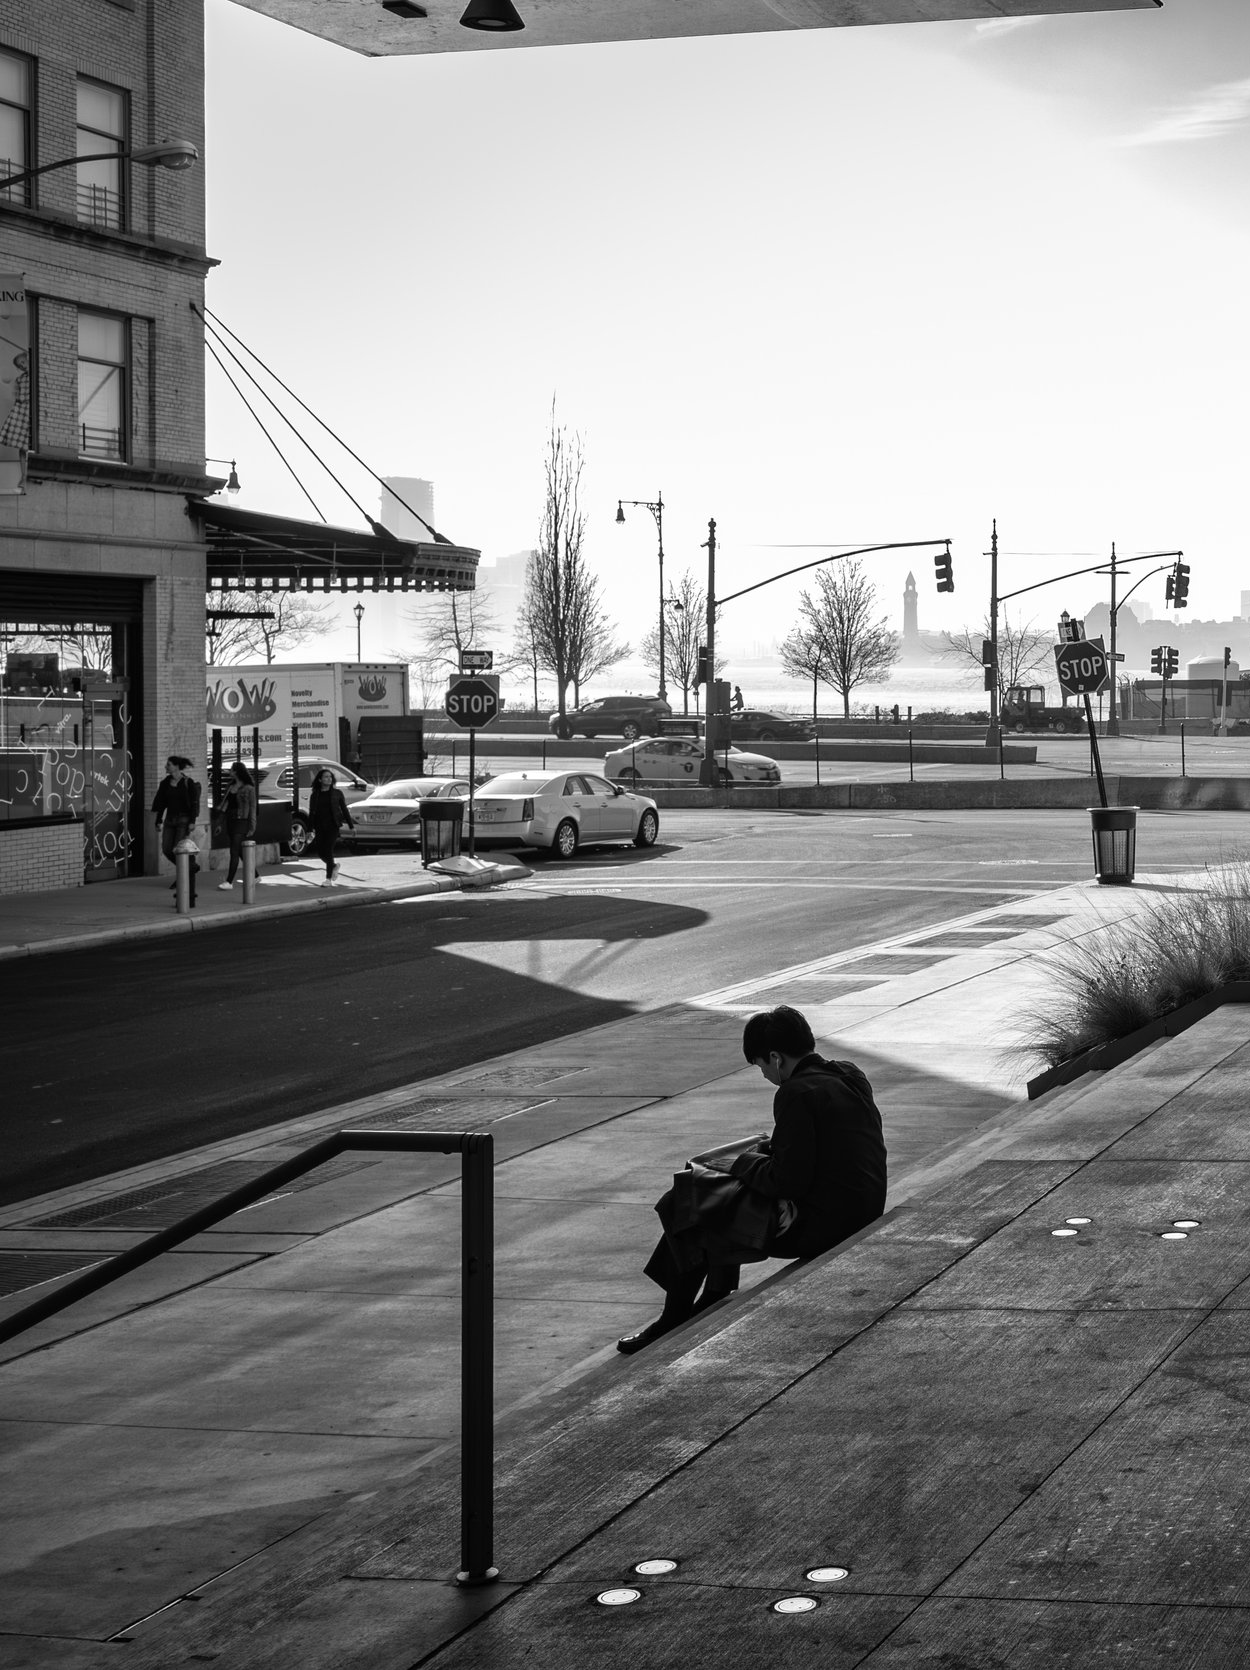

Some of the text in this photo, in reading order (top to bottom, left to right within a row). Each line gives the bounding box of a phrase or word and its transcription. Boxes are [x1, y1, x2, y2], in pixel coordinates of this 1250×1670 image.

[0, 291, 24, 302] ING
[463, 656, 474, 664] ONE
[1059, 656, 1103, 680] STOP
[290, 689, 313, 697] Novelty
[291, 699, 330, 708] Merchandise
[448, 694, 495, 713] STOP
[307, 732, 325, 740] Items
[297, 743, 329, 751] usic Items
